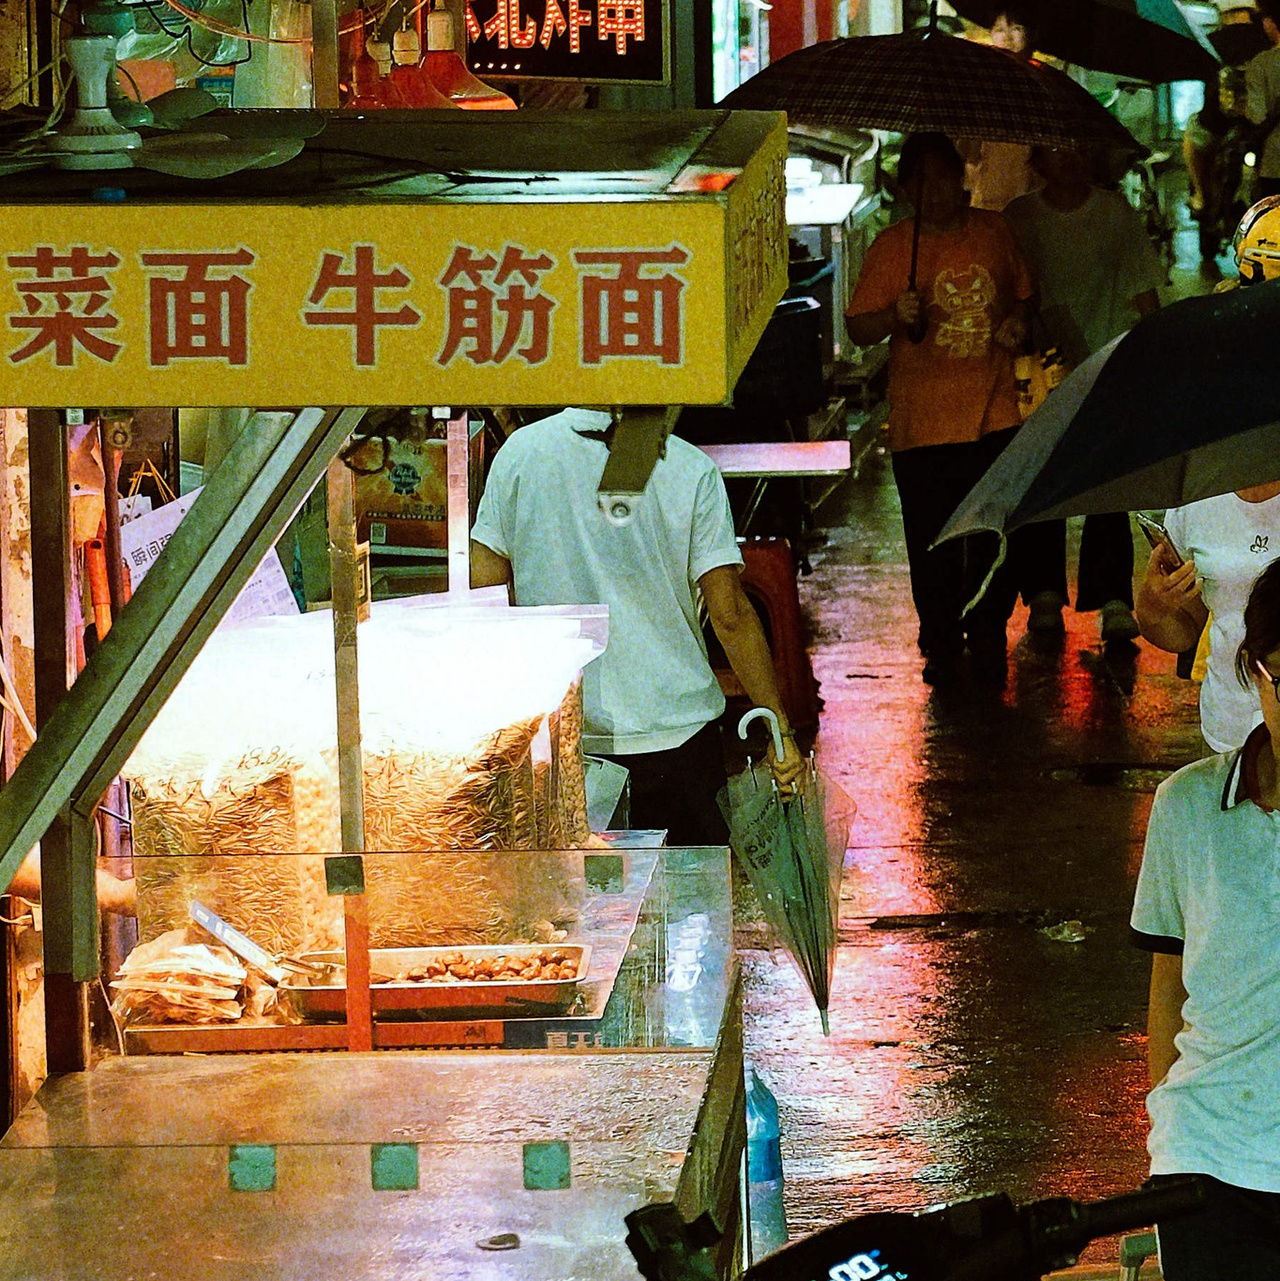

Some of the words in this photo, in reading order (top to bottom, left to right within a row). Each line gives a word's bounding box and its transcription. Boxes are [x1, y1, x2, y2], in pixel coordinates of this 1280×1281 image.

[6, 245, 255, 367] 菜面
[304, 245, 689, 367] 牛筋面
